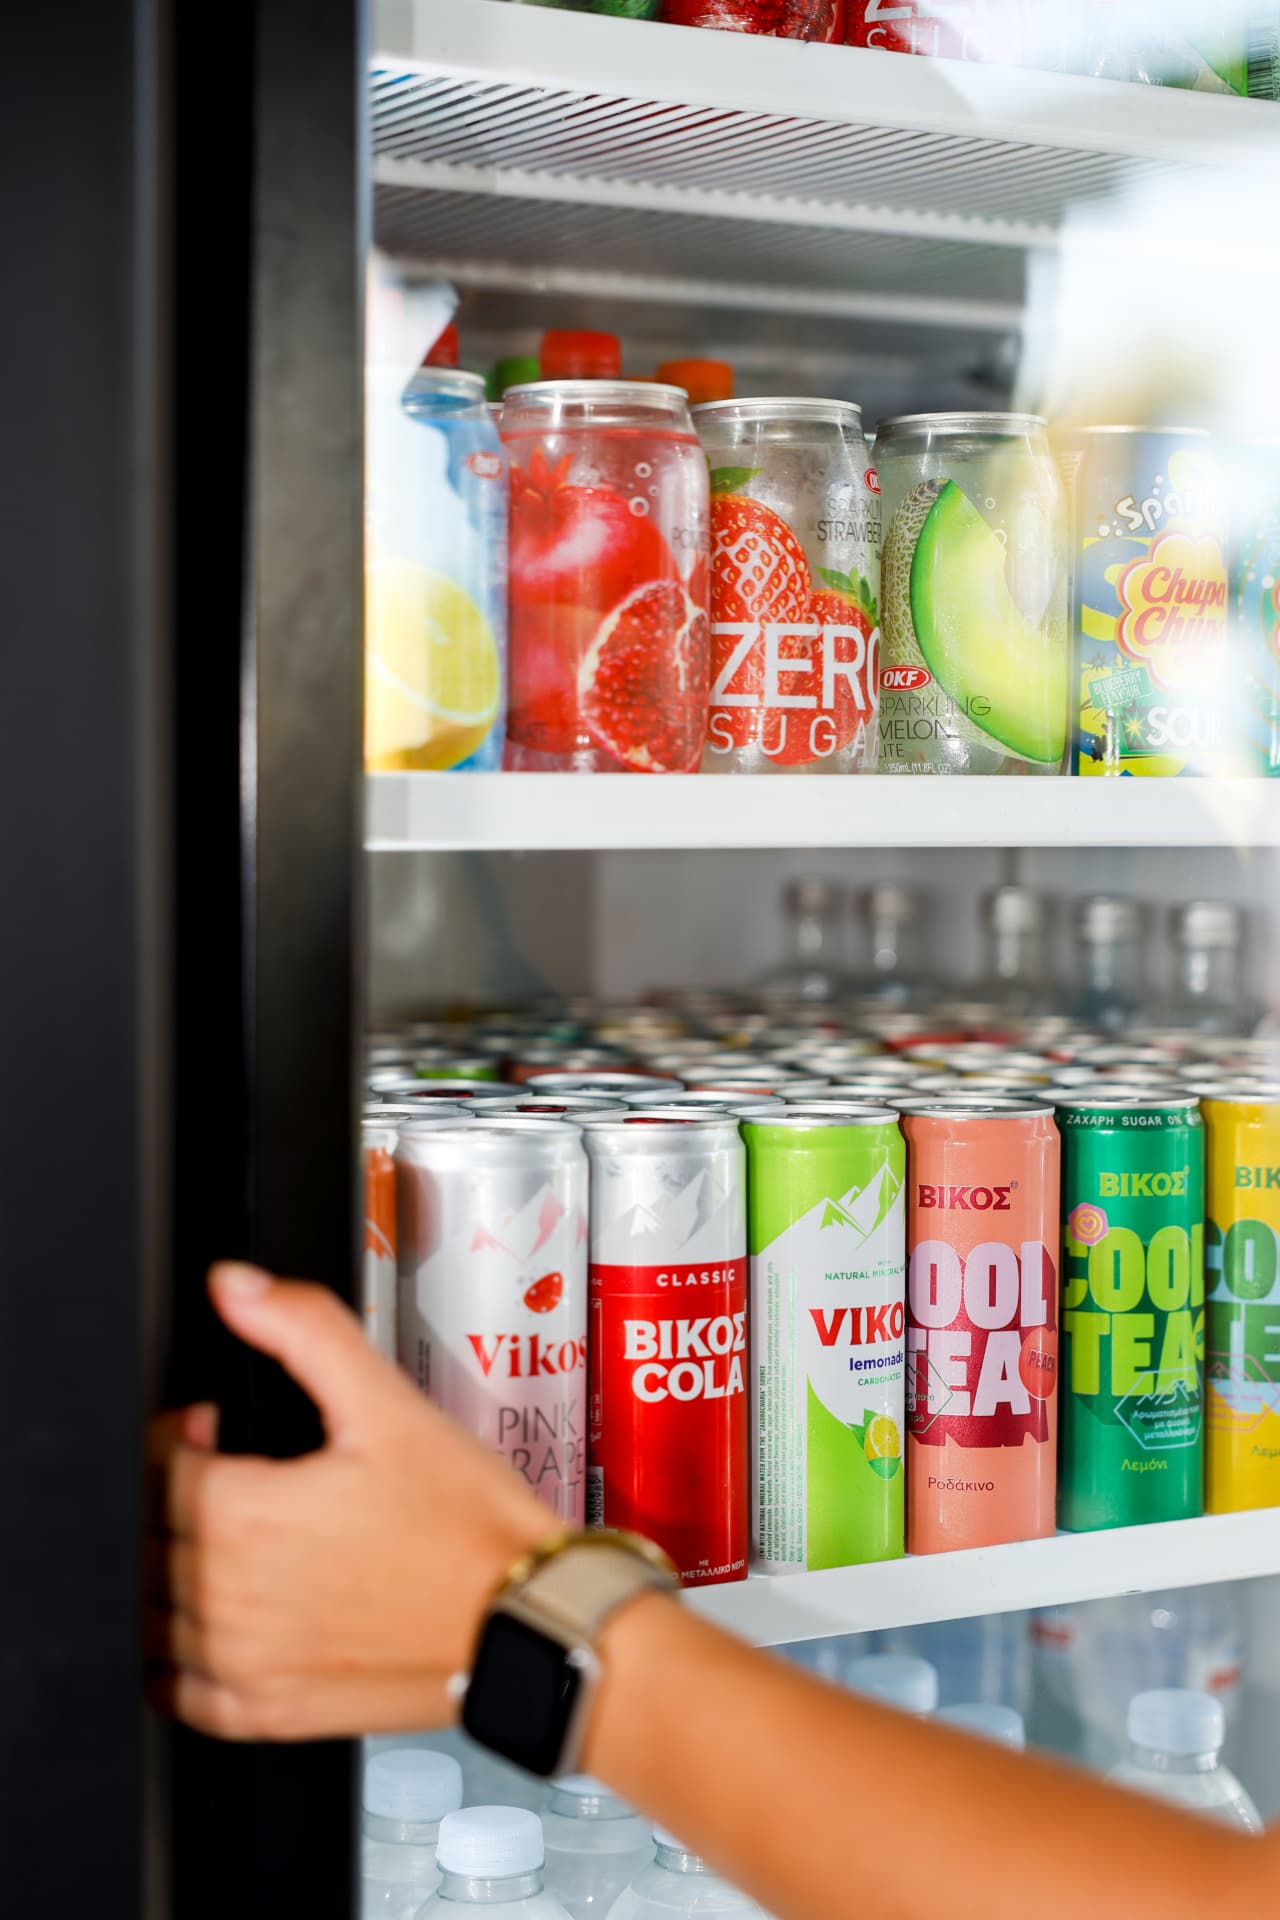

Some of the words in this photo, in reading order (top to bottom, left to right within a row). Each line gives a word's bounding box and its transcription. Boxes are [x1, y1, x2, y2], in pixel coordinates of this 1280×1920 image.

[709, 622, 880, 711] ZERO
[883, 670, 918, 687] OKF
[1121, 1116, 1163, 1126] SUGAR
[1098, 1171, 1185, 1197] ΒΙΚΟΣ
[917, 1184, 1012, 1211] ΒΙΚΟΣ
[656, 1268, 735, 1287] CLASSIC
[825, 1271, 871, 1280] NATURAL
[623, 1312, 746, 1360] ΒΙΚΟΣ
[1063, 1310, 1198, 1397] TEA
[631, 1355, 745, 1403] COLA
[498, 1402, 577, 1445] PINK
[496, 1437, 584, 1487] RAPE
[1121, 1457, 1168, 1474] Λεμόνι
[927, 1476, 995, 1492] Ροδάκινο
[681, 1564, 731, 1579] ΜΕΤΑΛΛΙΚΟ
